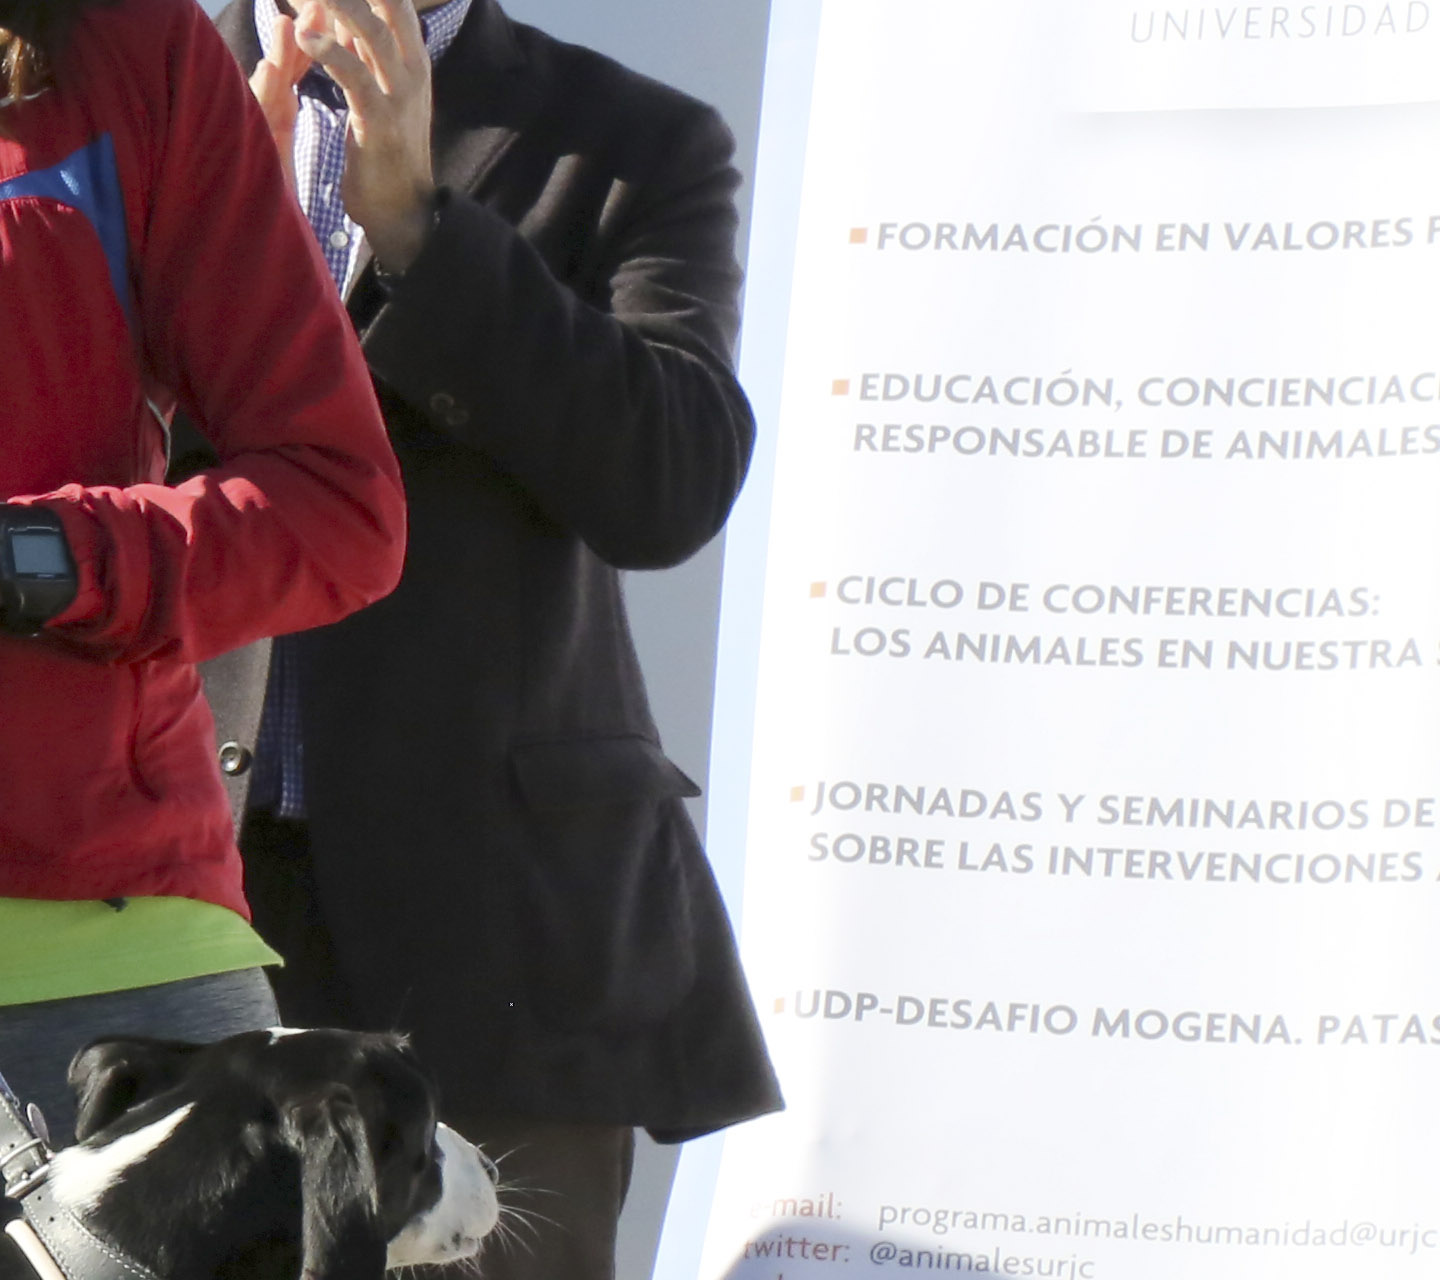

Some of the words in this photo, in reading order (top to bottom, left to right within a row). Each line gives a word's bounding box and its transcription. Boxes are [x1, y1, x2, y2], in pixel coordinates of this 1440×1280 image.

[1129, 0, 1429, 44] UNIVERSIDAD
[878, 216, 1142, 253] FORMACIÓN
[1156, 223, 1209, 251] EN
[1224, 218, 1413, 251] VALORES
[860, 369, 1122, 411] EDUCACIÓN,
[1138, 373, 1440, 407] CONCIENCIAC
[854, 424, 1147, 457] RESPONSABLE
[1161, 430, 1213, 458] DE
[1225, 425, 1440, 459] ANIMALES
[837, 576, 963, 608] CICLO
[977, 582, 1029, 612] DE
[1043, 584, 1379, 618] CONFERENCIAS:
[831, 627, 911, 658] LOS
[924, 631, 1143, 667] ANIMALES
[1158, 639, 1213, 669] EN
[1227, 638, 1422, 670] NUESTRA
[812, 781, 1042, 821] JORNADAS
[1058, 794, 1085, 823] Y
[1097, 795, 1368, 830] SEMINARIOS
[1384, 798, 1435, 827] DE
[810, 833, 945, 868] SOBRE
[958, 841, 1033, 874] LAS
[1048, 846, 1422, 883] INTERVENCIONES
[794, 990, 1077, 1036] UDP-DESAFIO
[1092, 1008, 1301, 1044] MOGENA.
